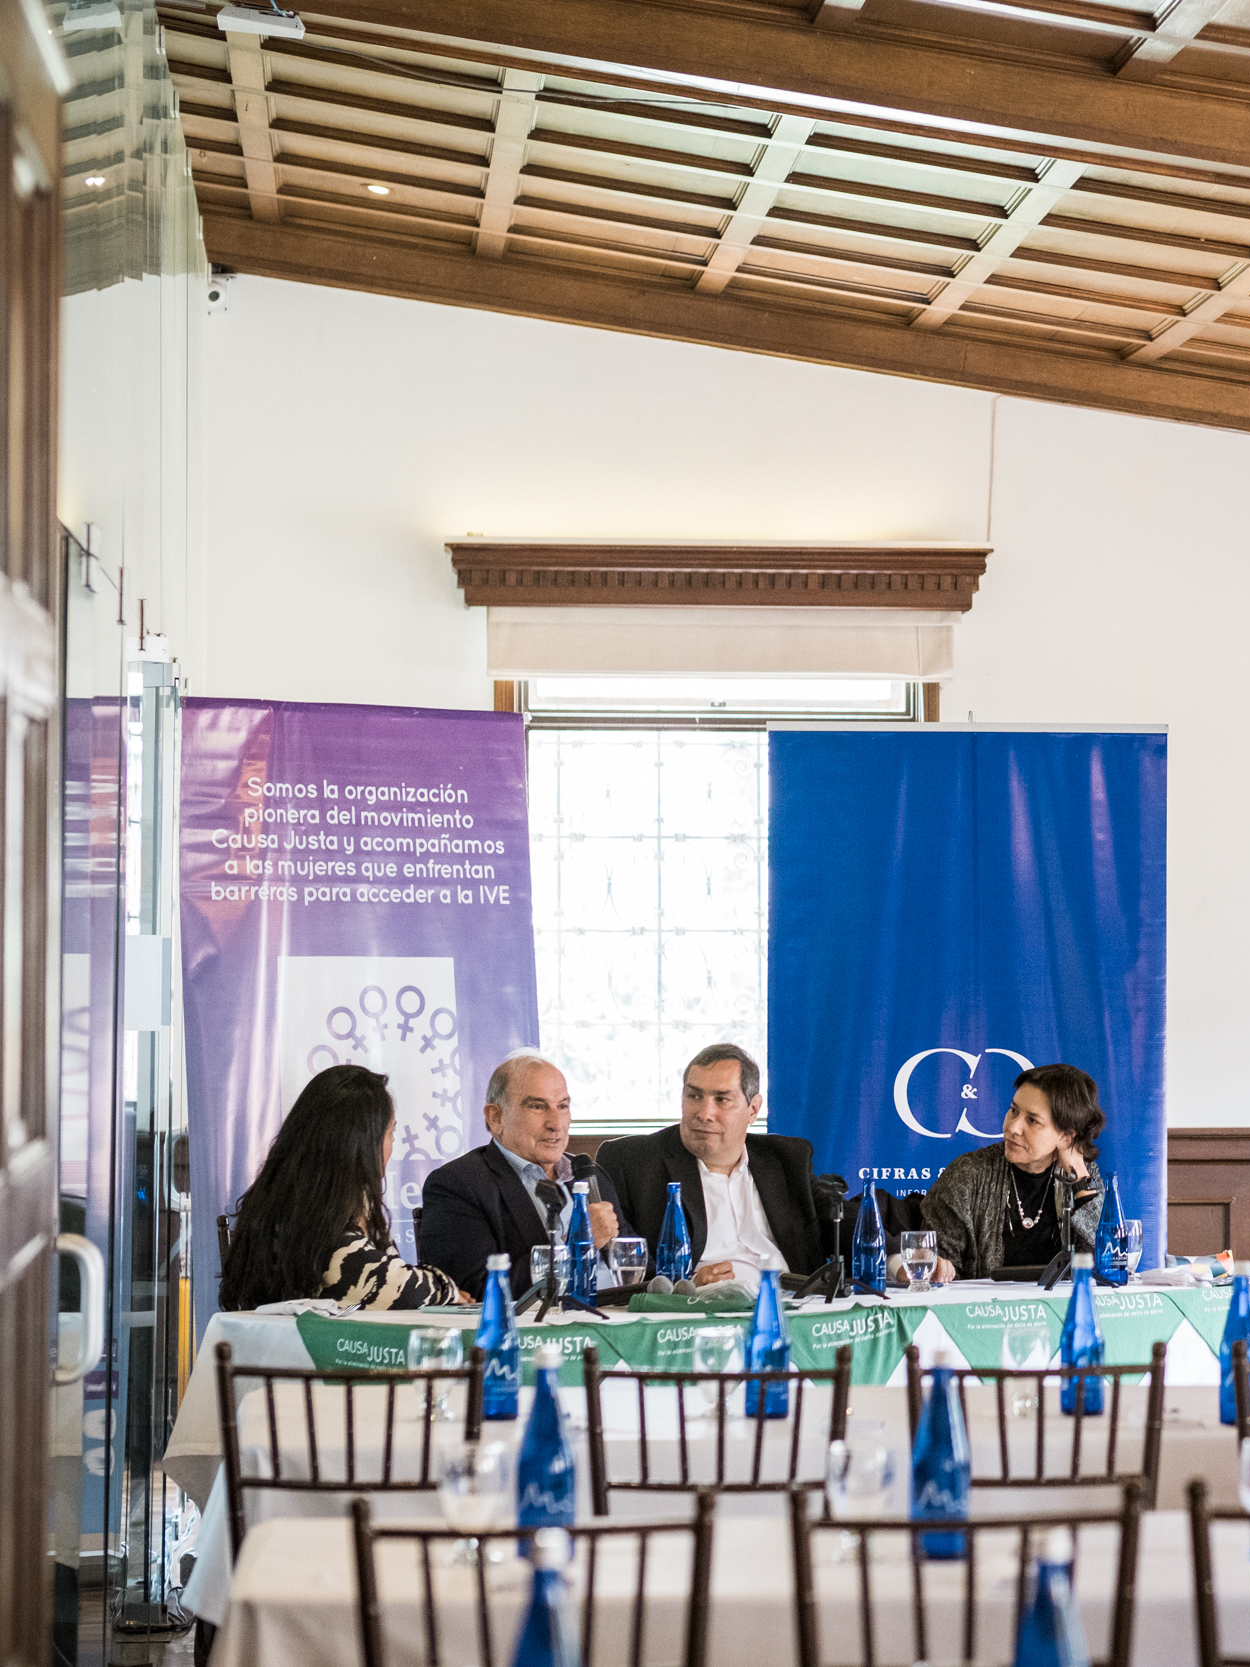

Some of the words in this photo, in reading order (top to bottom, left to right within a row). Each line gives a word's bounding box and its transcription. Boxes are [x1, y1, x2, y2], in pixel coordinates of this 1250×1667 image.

[247, 777, 317, 798] Somos
[323, 779, 339, 799] la
[344, 782, 468, 805] organización
[244, 804, 320, 827] pionera
[326, 805, 356, 825] del
[361, 808, 474, 829] movimiento
[211, 829, 278, 849] Causa
[283, 830, 338, 850] Justa
[345, 835, 354, 855] y
[360, 833, 505, 857] acompañamos
[224, 859, 238, 874] a
[246, 855, 273, 875] las
[278, 856, 356, 880] mujeres
[361, 861, 397, 881] que
[403, 859, 494, 879] enfrentan
[211, 881, 298, 901] barreras
[304, 886, 351, 906] para
[356, 884, 435, 904] acceder
[439, 888, 451, 904] a
[457, 885, 473, 904] la
[480, 885, 510, 905] IVE
[858, 1167, 931, 1180] CIFRAS
[966, 1304, 1003, 1318] CAUSA
[1002, 1303, 1047, 1321] JUSTA
[1119, 1293, 1163, 1310] JUSTA
[657, 1326, 696, 1343] CAUSA
[812, 1319, 850, 1336] CAUSA
[849, 1311, 894, 1336] JUSTA
[337, 1338, 368, 1355] CAUSA
[366, 1345, 406, 1365] JUSTA
